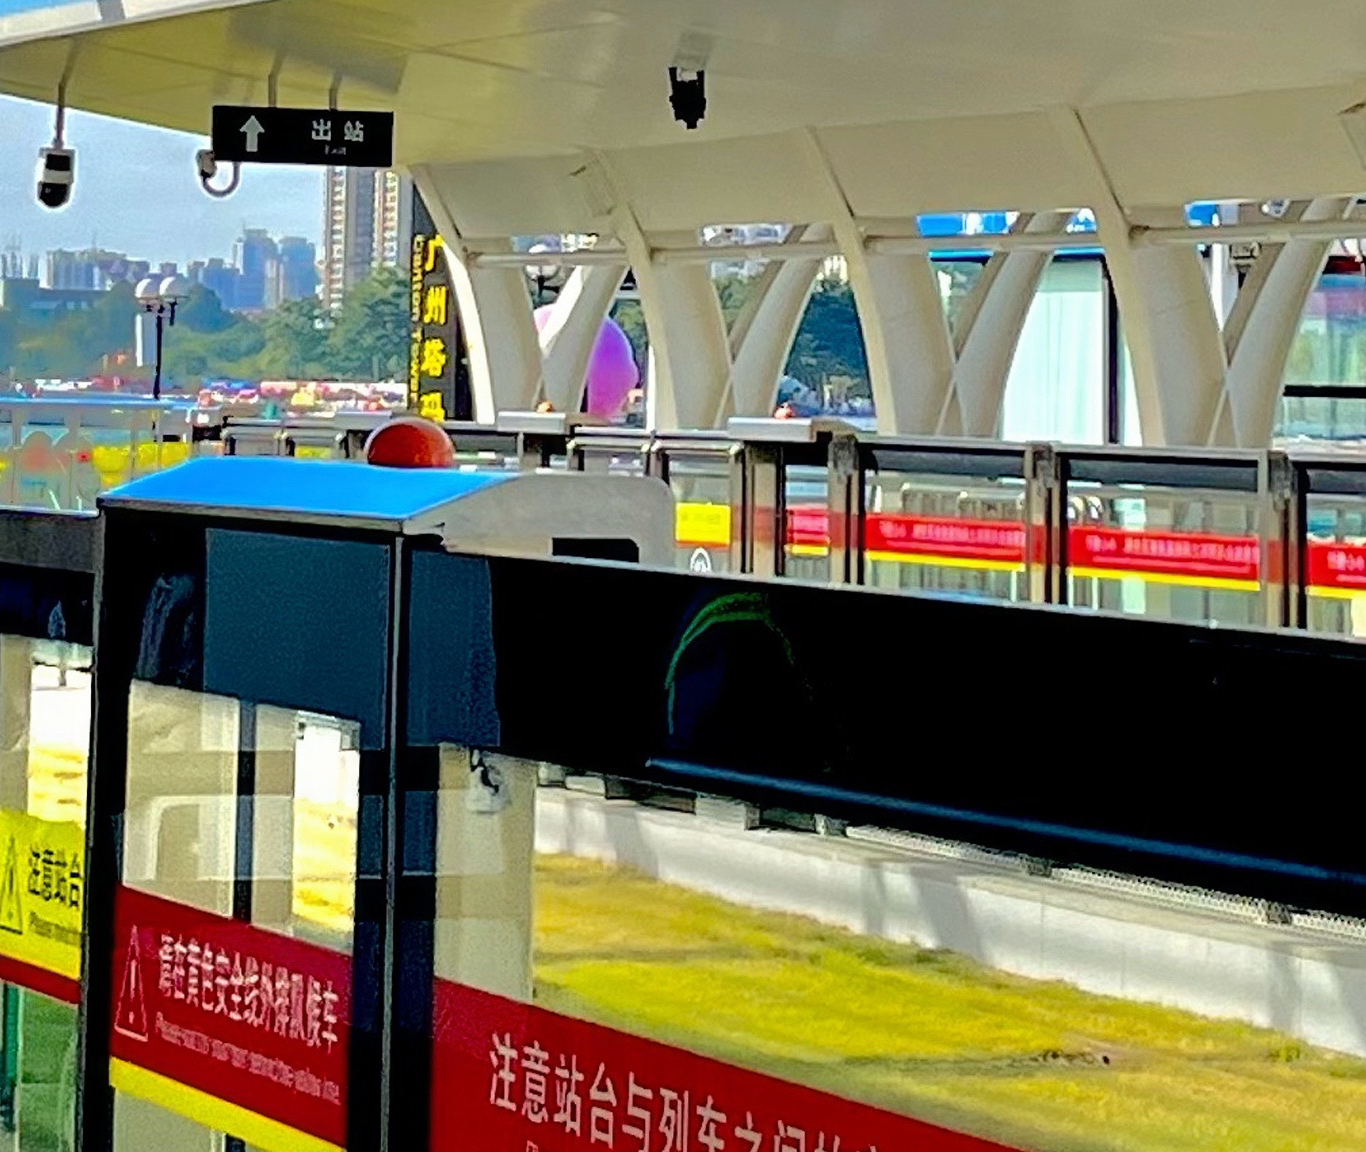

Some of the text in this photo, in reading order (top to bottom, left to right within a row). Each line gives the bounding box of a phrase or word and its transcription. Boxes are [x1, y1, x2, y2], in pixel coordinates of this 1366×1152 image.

[311, 119, 364, 142] 出站
[158, 930, 339, 1054] 请在黄色安全线外排队候车
